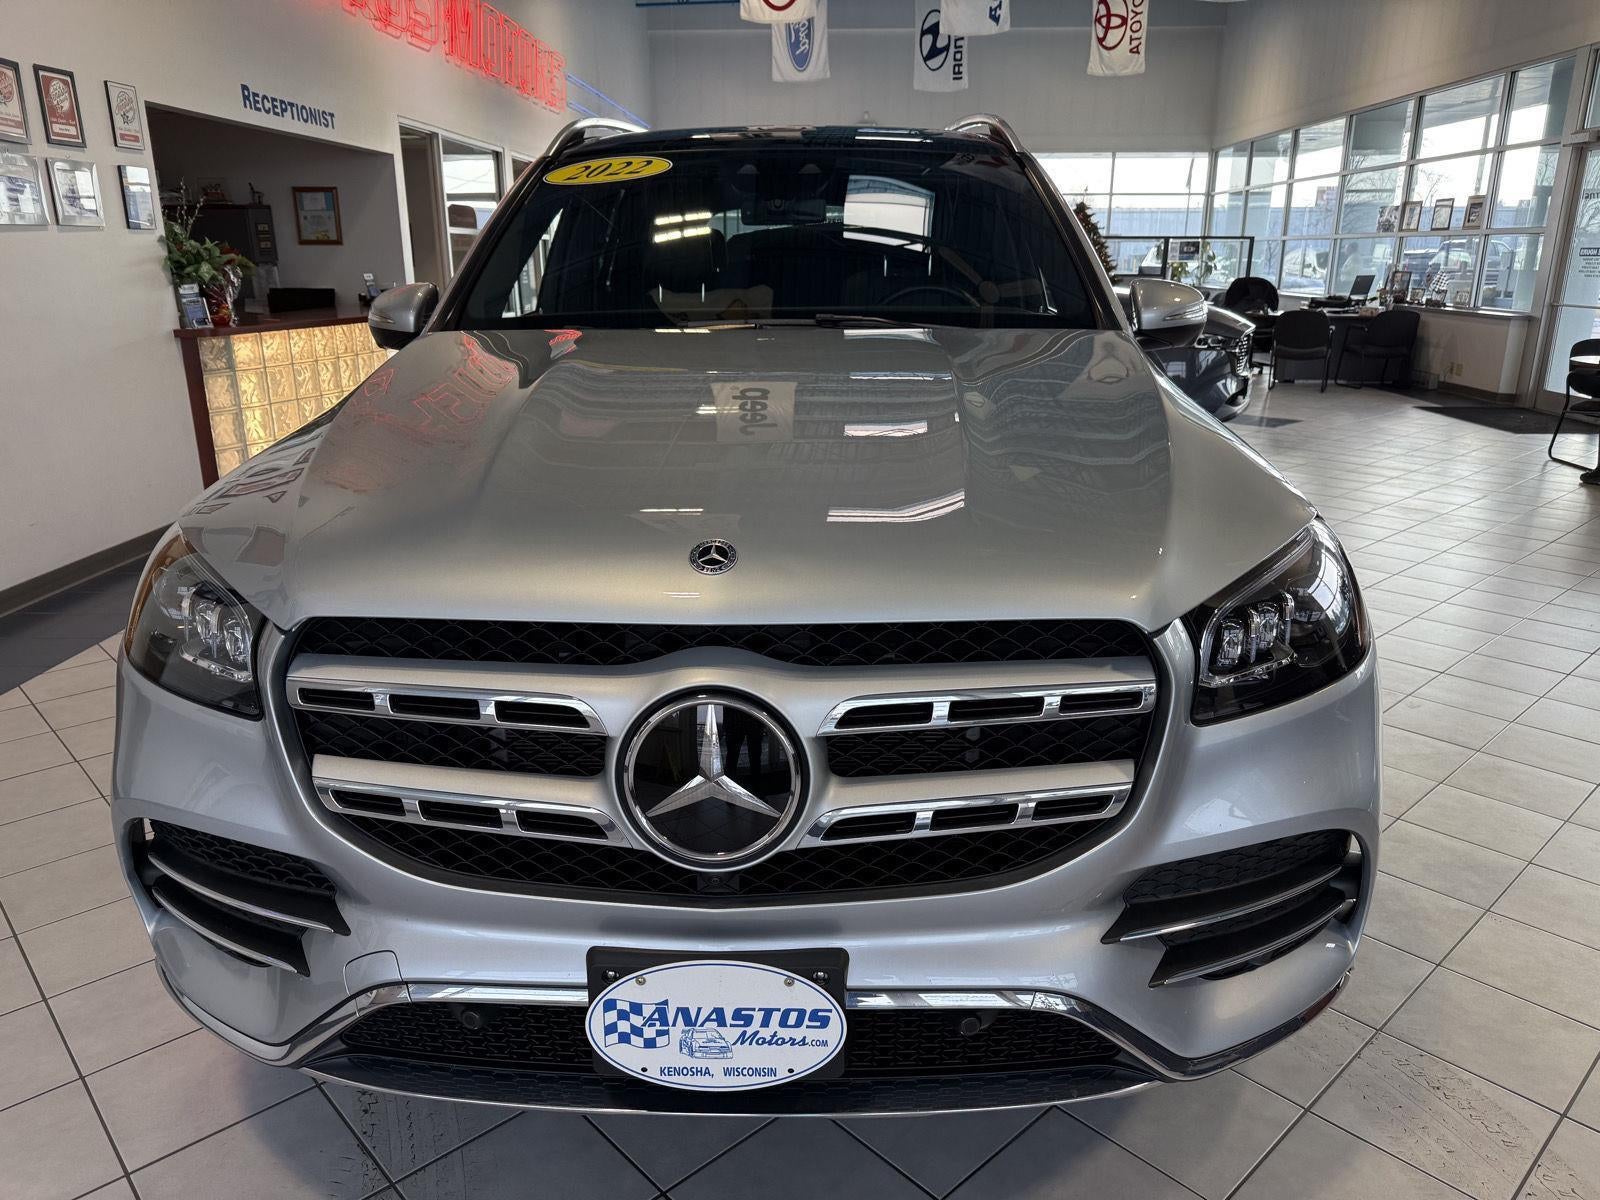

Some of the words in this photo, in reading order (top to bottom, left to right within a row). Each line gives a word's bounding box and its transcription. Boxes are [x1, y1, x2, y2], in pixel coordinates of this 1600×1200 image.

[240, 83, 335, 130] RECEPTIONIST
[565, 160, 646, 181] 2022
[641, 1007, 832, 1028] ANASTOS
[660, 1066, 714, 1078] KENOSHA,
[723, 1066, 777, 1077] WISCONSIN
